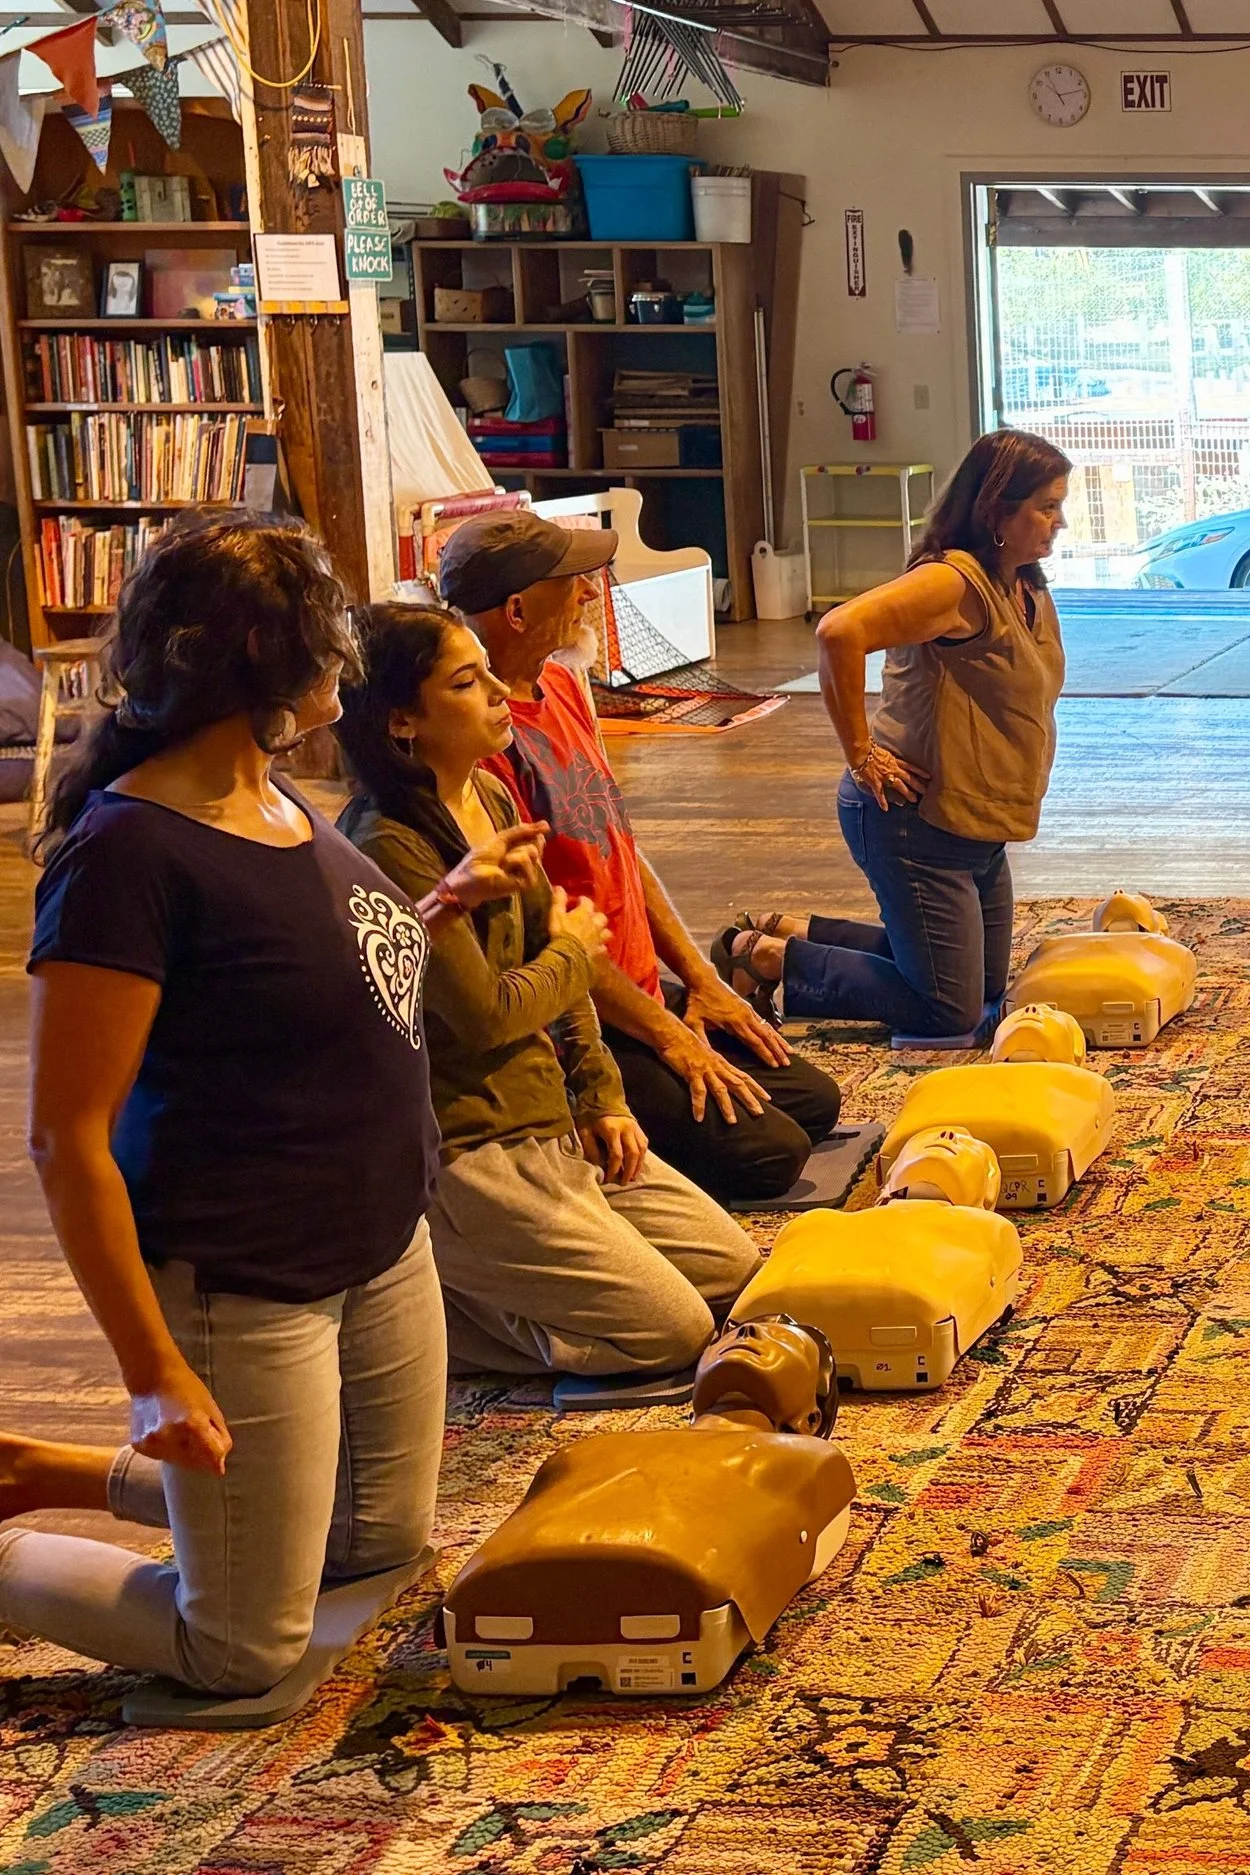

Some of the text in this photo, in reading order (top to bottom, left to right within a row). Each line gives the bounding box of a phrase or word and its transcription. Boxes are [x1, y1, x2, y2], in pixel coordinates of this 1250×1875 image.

[1123, 74, 1168, 108] EXIT
[348, 208, 385, 226] ORDER
[846, 214, 863, 223] FIRE
[347, 233, 387, 254] PLEASE
[351, 254, 389, 273] KNOCK
[851, 224, 860, 291] EXTINGUISHER
